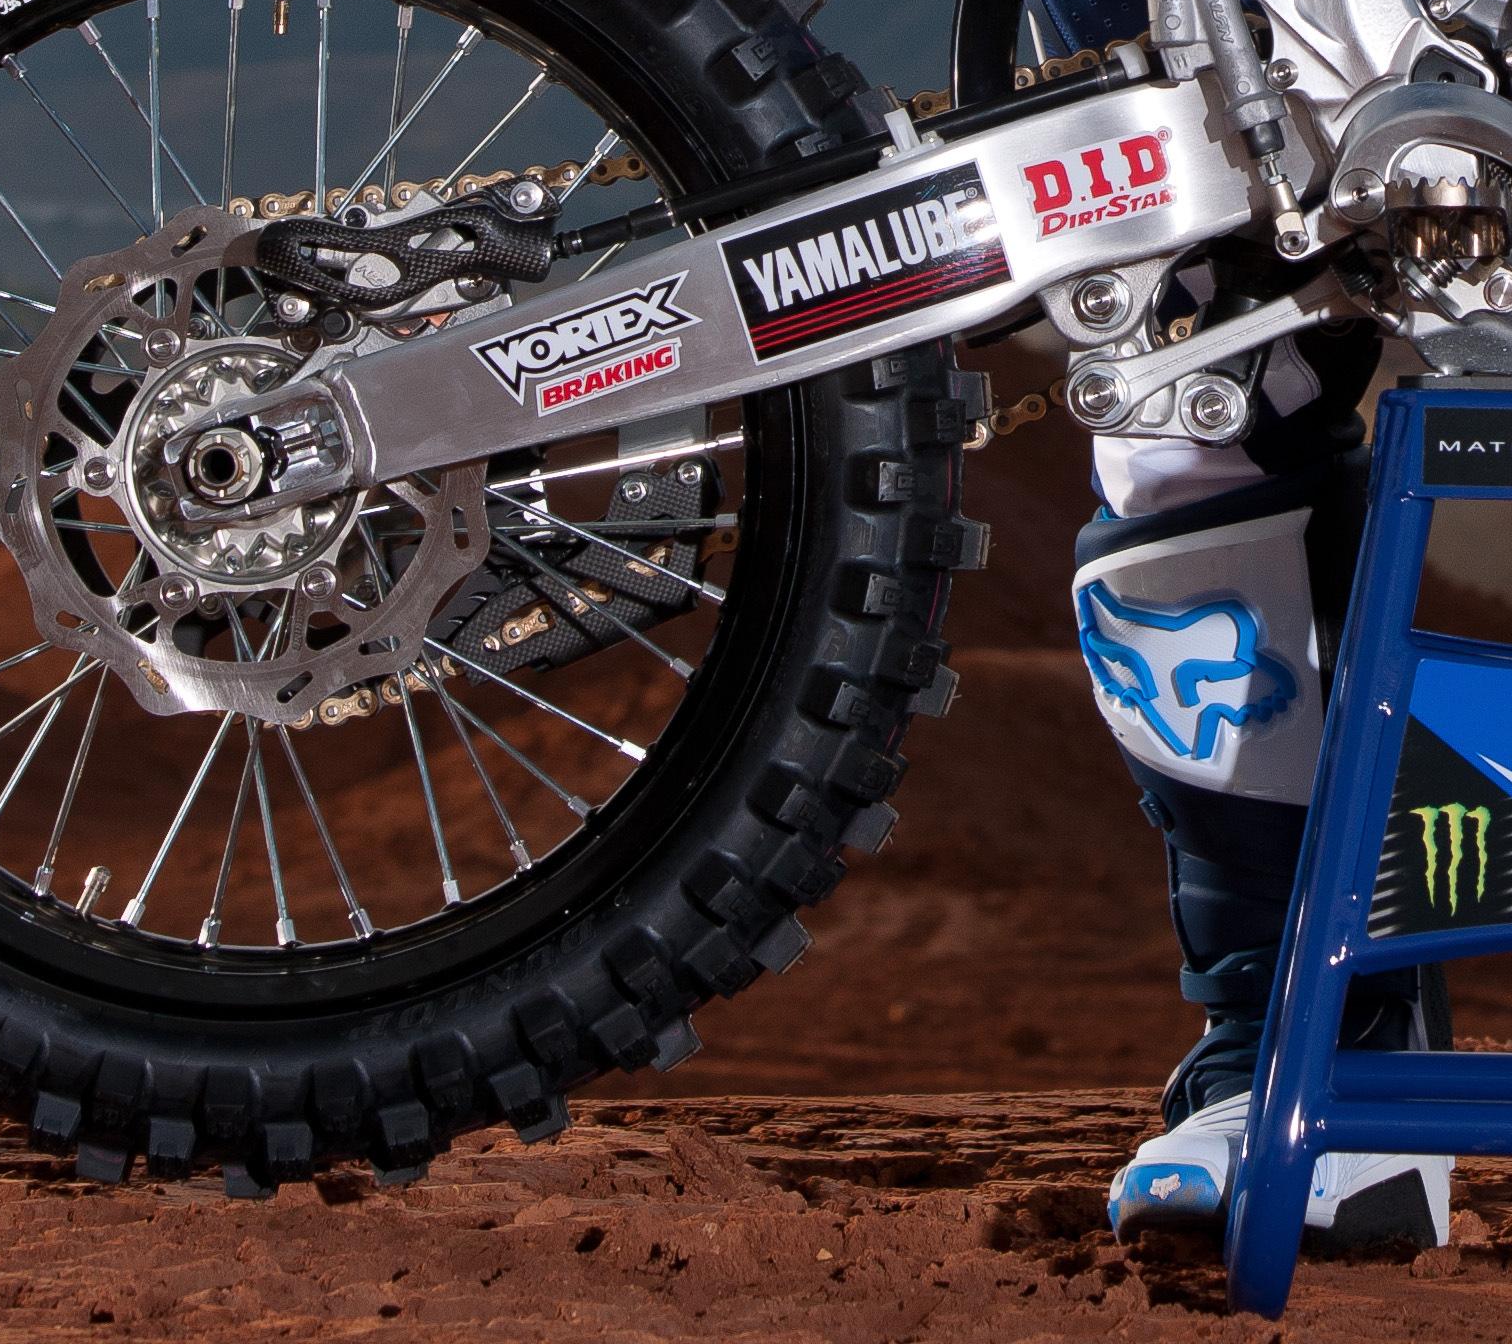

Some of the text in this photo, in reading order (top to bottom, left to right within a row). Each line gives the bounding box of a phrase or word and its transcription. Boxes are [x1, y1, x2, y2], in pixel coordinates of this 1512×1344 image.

[1024, 135, 1168, 214] D.I.D
[742, 191, 978, 312] YAMALUBE
[476, 276, 696, 390] VORTEX
[541, 341, 678, 411] BRAKING
